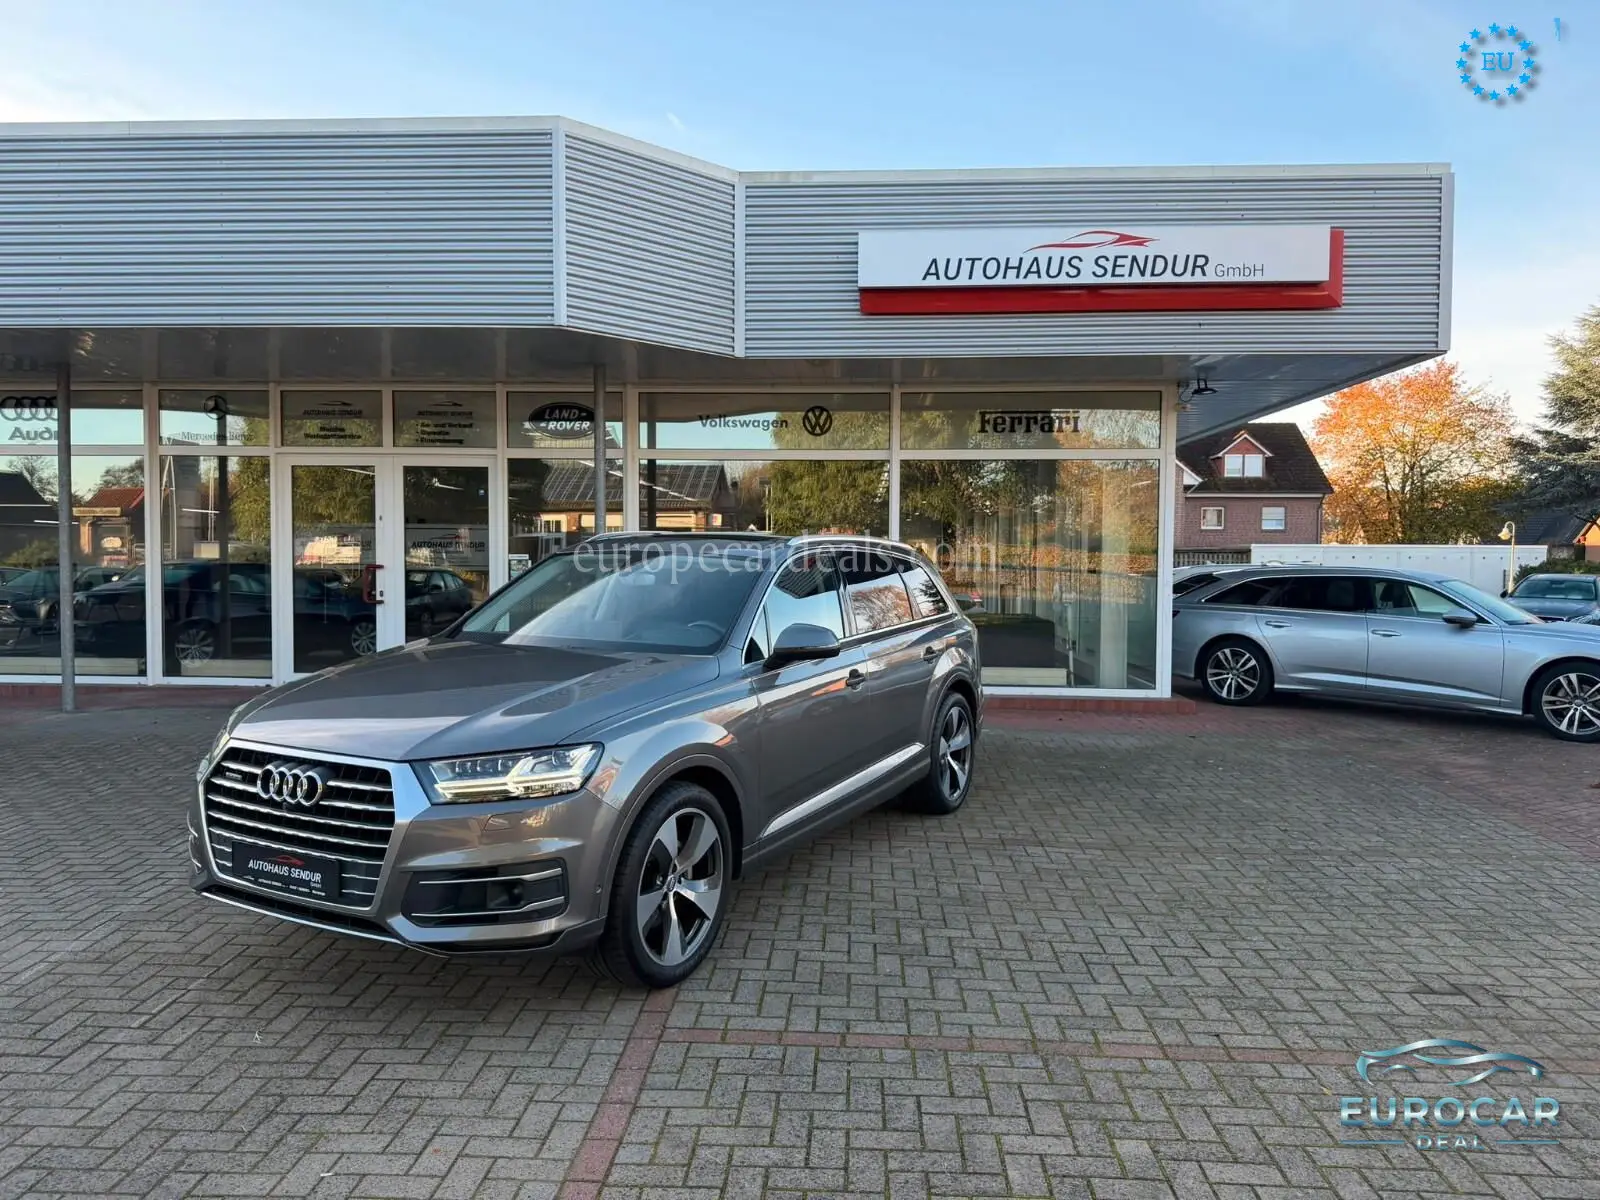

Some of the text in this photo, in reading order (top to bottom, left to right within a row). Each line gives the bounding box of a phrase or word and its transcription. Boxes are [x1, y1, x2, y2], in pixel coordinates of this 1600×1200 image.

[922, 254, 1265, 281] AUTOHAUS SENDUR GmbH
[699, 414, 789, 431] Volkswagen
[978, 410, 1081, 433] Ferrari
[248, 859, 289, 876] AUTOHAUS
[290, 868, 322, 883] SENDUR
